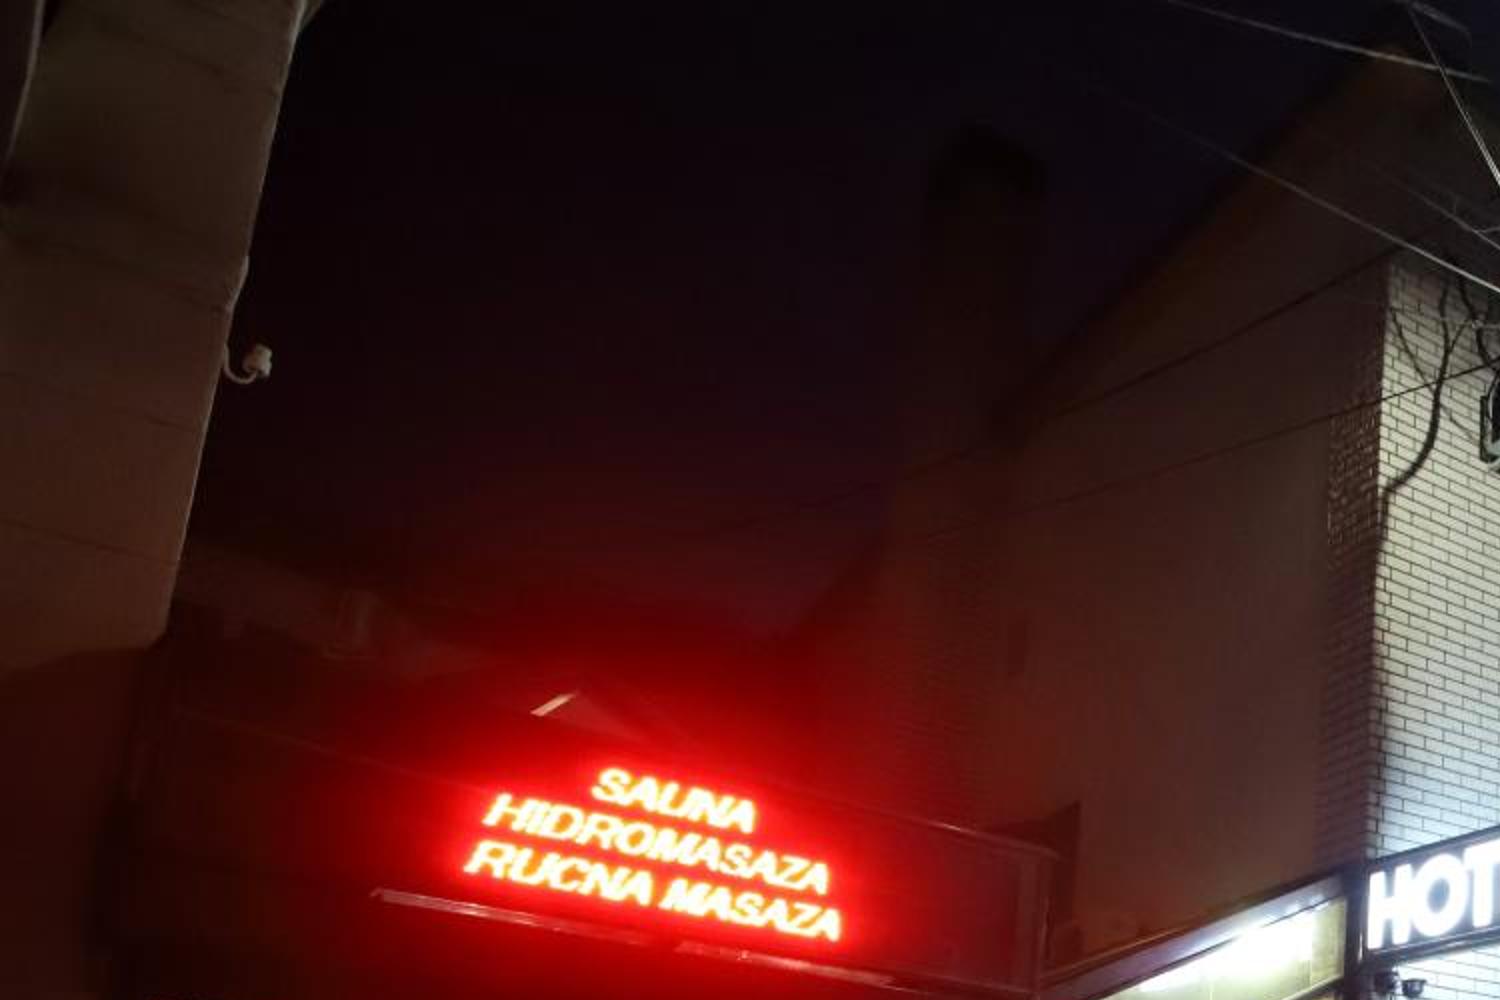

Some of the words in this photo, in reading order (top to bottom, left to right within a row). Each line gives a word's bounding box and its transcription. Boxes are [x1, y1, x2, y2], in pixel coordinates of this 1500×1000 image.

[483, 793, 830, 895] HIDROMASAZA
[591, 767, 757, 834] SAUNA
[464, 840, 655, 906] RUCNA
[659, 877, 842, 942] MASAZA
